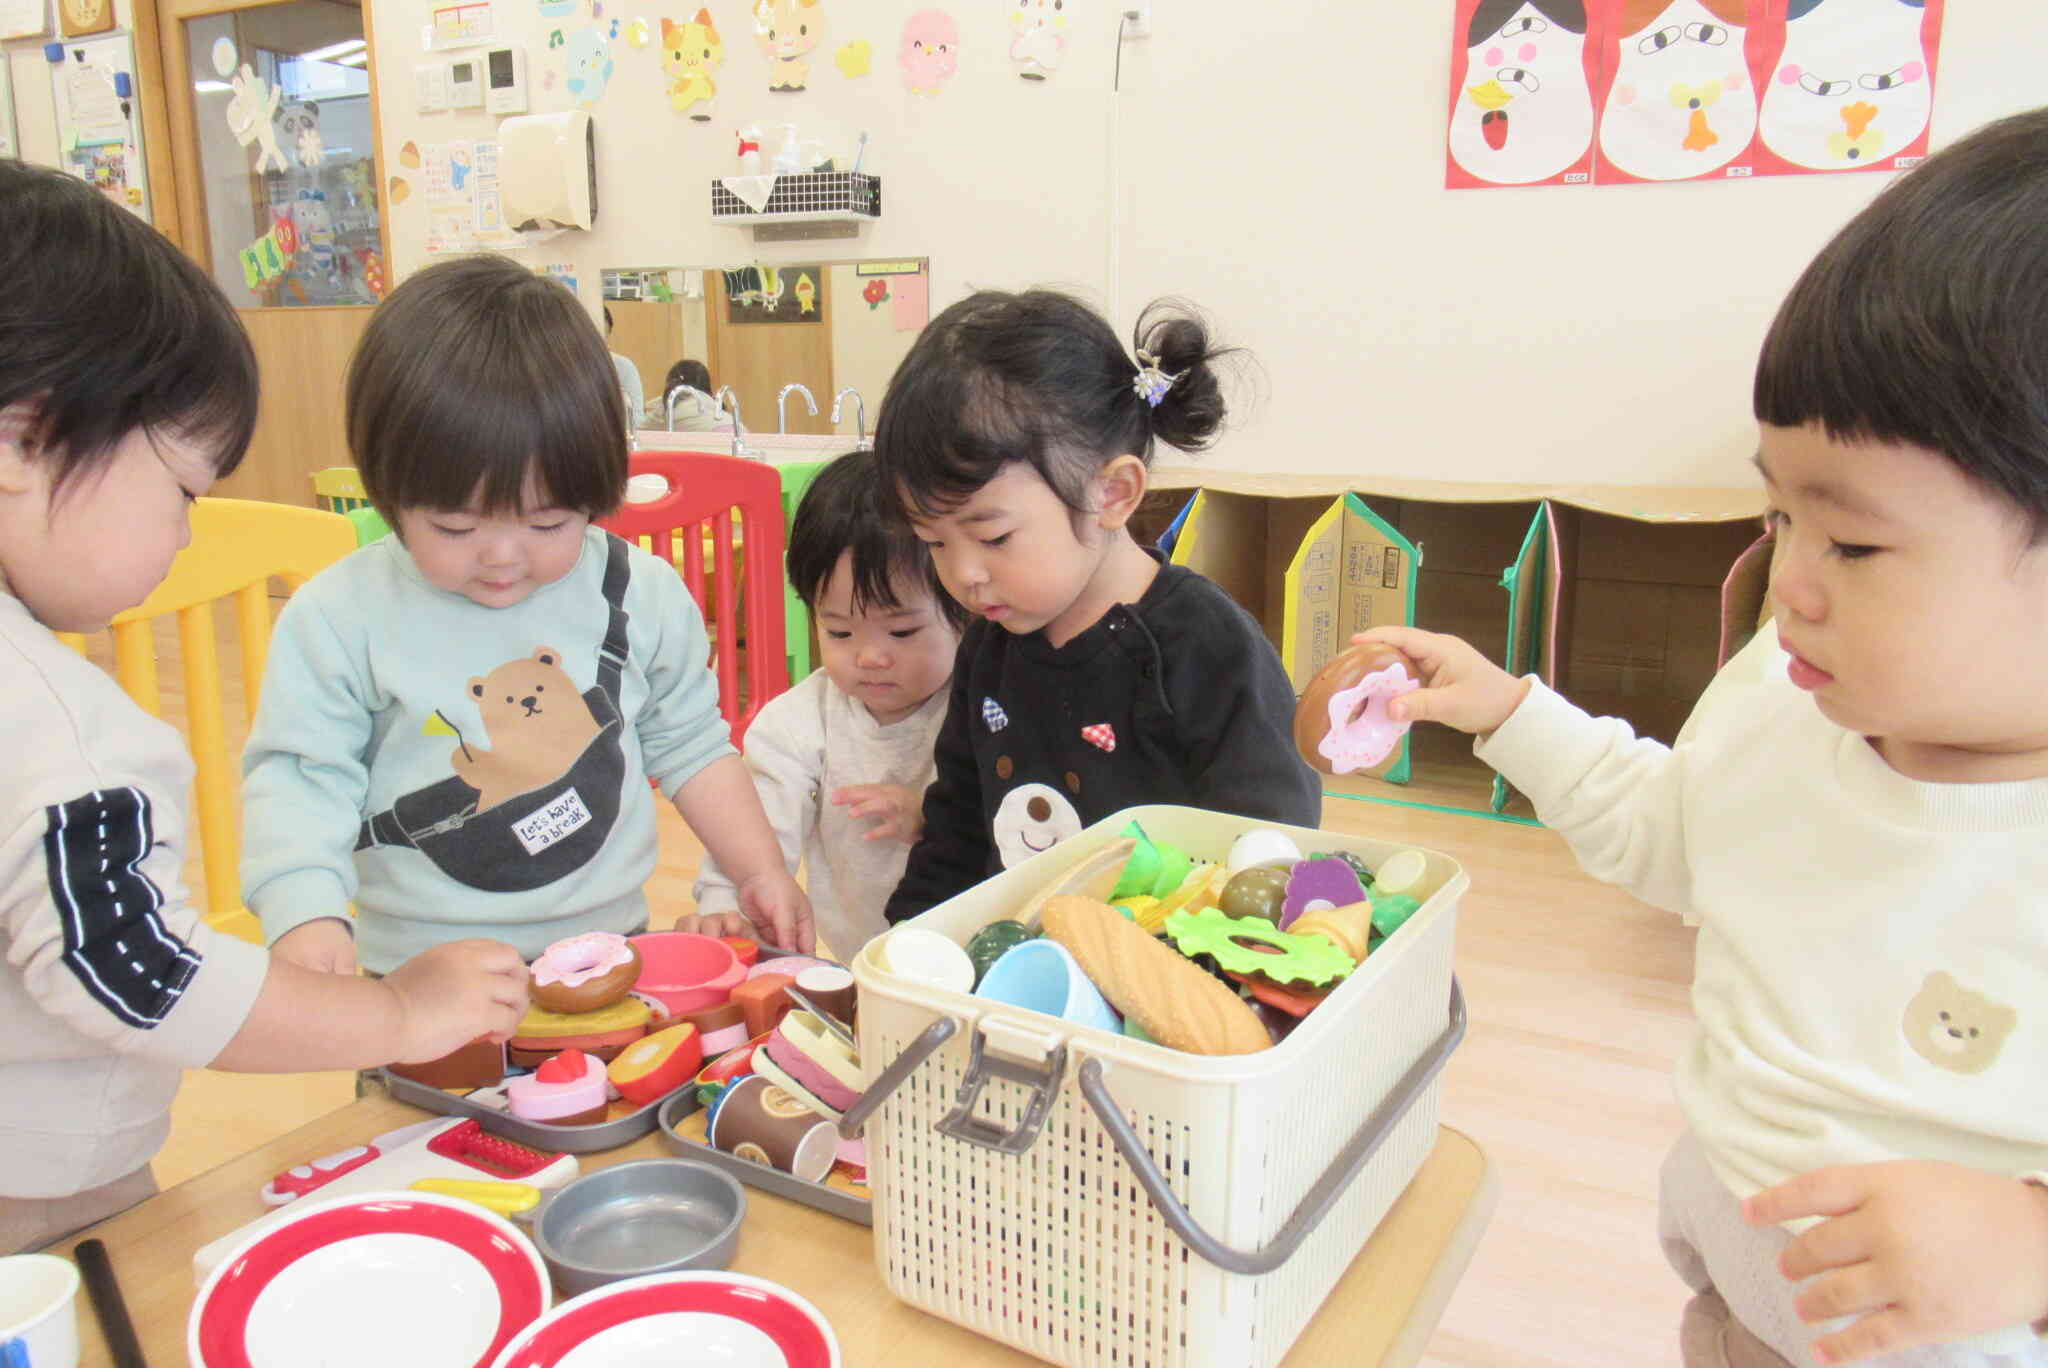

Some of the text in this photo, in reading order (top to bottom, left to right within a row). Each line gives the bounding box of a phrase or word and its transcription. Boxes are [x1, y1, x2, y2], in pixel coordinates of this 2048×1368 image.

[520, 796, 577, 841] Let's have
[539, 807, 585, 844] a break
